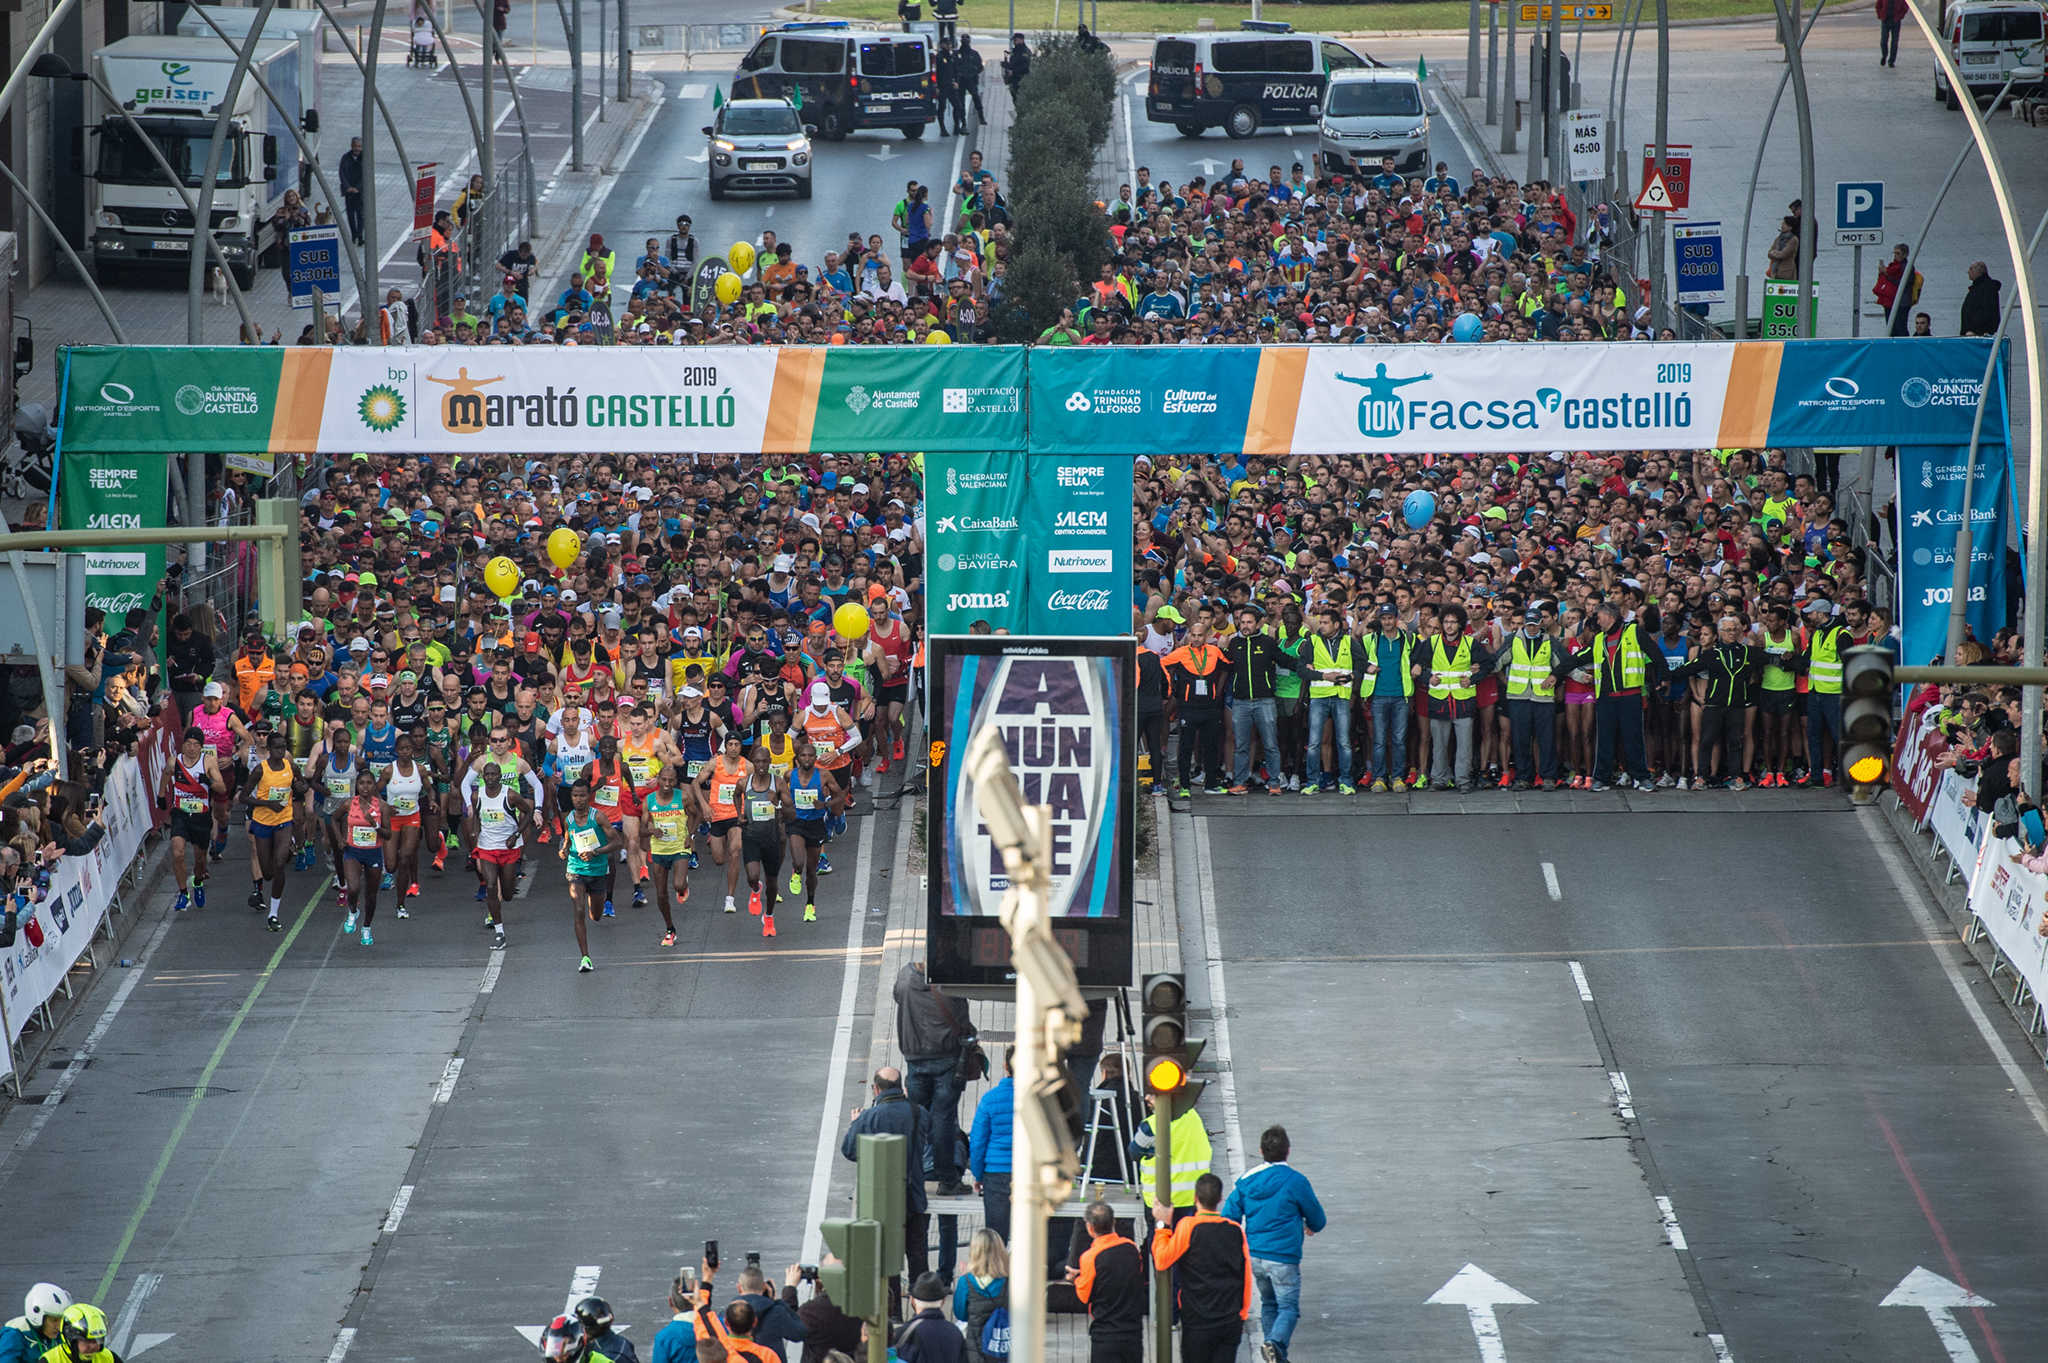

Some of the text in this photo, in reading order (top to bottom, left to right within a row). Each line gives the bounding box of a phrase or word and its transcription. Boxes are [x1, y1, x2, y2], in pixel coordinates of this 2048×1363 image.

[136, 86, 214, 103] geiser
[1574, 142, 1600, 154] 45:00
[1847, 189, 1872, 224] P
[300, 250, 328, 264] SUB
[1684, 245, 1712, 258] SUB
[293, 266, 338, 282] 3:30H.
[1681, 262, 1718, 275] 40:00
[1774, 304, 1798, 317] SU
[388, 366, 408, 383] bp
[684, 366, 716, 386] 2019
[1657, 363, 1691, 383] 2019
[872, 390, 920, 400] Ajuntament
[968, 386, 1016, 395] DIPUTACIÓ
[1164, 389, 1206, 401] Cultura
[204, 392, 256, 402] RUNNING
[1094, 396, 1141, 405] TRINIDAD
[448, 386, 735, 427] marató CASTELLÓ
[872, 400, 918, 408] de Castelló
[1094, 405, 1141, 414] ALFONSO
[1163, 401, 1217, 413] Esfuerzo
[1363, 400, 1401, 431] 10K
[1564, 392, 1691, 429] castelló
[89, 469, 138, 479] SEMPRE
[959, 472, 1008, 481] GENERALITAT
[1057, 466, 1104, 476] SEMPRE
[89, 479, 122, 488] TEUA
[1057, 477, 1089, 486] TEUA
[1054, 511, 1107, 526] SALERA
[1936, 508, 1997, 521] CaixBank
[960, 516, 1018, 528] CaixaBank
[958, 560, 1018, 570] BAVIERA
[1054, 556, 1107, 566] Nutrinovex
[1048, 589, 1112, 610] Coca-Cola
[996, 660, 1091, 715] A
